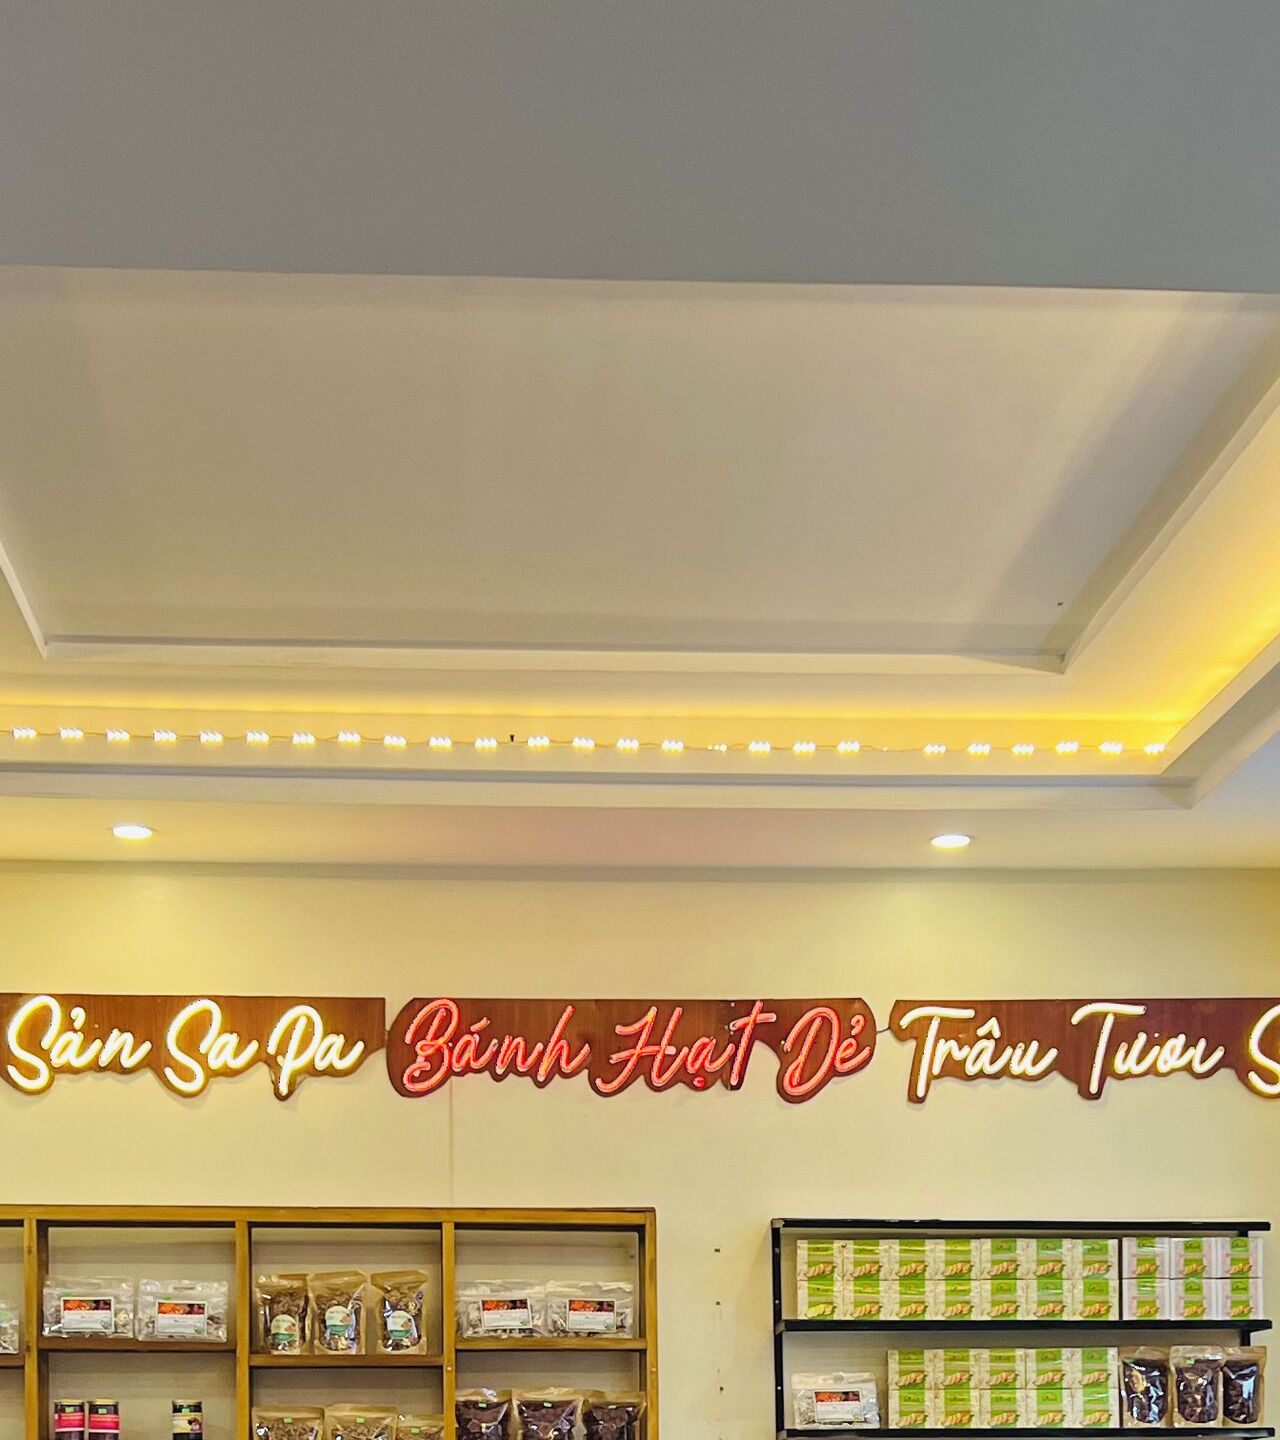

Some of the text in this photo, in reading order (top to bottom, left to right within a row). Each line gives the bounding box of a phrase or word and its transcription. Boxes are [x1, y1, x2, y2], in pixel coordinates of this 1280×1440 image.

[5, 993, 153, 1092] Sản
[162, 998, 259, 1093] Sa
[265, 1004, 365, 1099] Pa
[402, 998, 873, 1096] Bánh Hạt Dẻ
[899, 1005, 1058, 1098] Trâu
